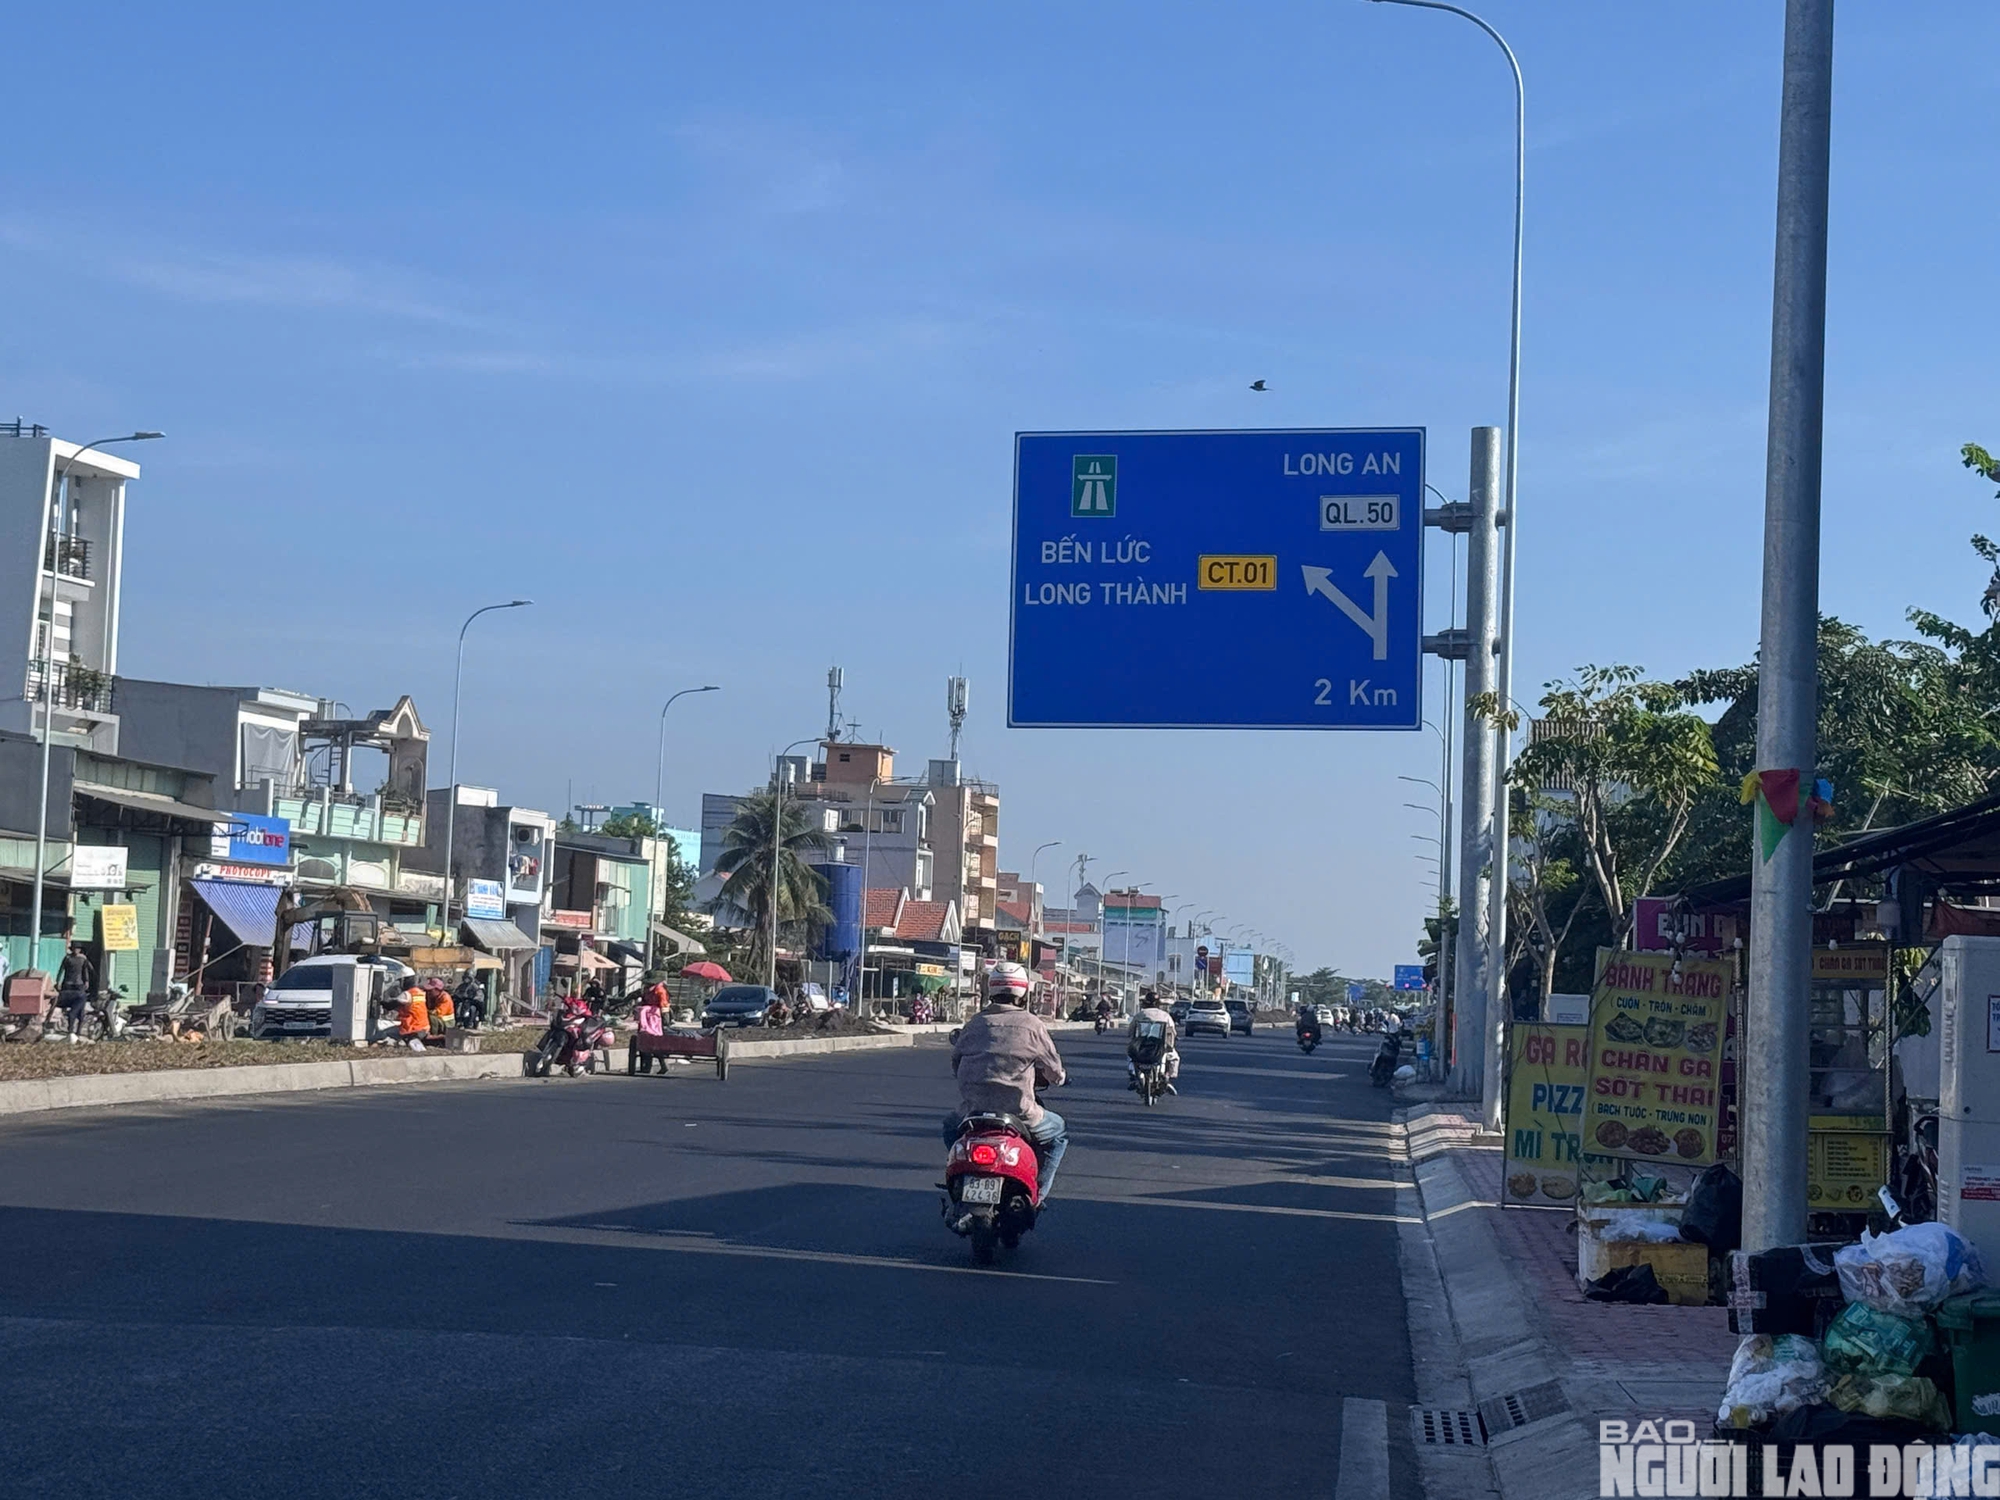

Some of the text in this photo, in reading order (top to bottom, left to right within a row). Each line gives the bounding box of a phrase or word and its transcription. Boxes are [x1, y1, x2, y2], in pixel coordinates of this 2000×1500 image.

[1283, 452, 1401, 475] LONG AN
[1325, 502, 1394, 524] QL.50
[1040, 534, 1151, 564] BẾN LỨC
[1207, 561, 1269, 584] CT.01
[1024, 576, 1188, 606] LONG THÀNH
[1313, 678, 1398, 706] 2 Km
